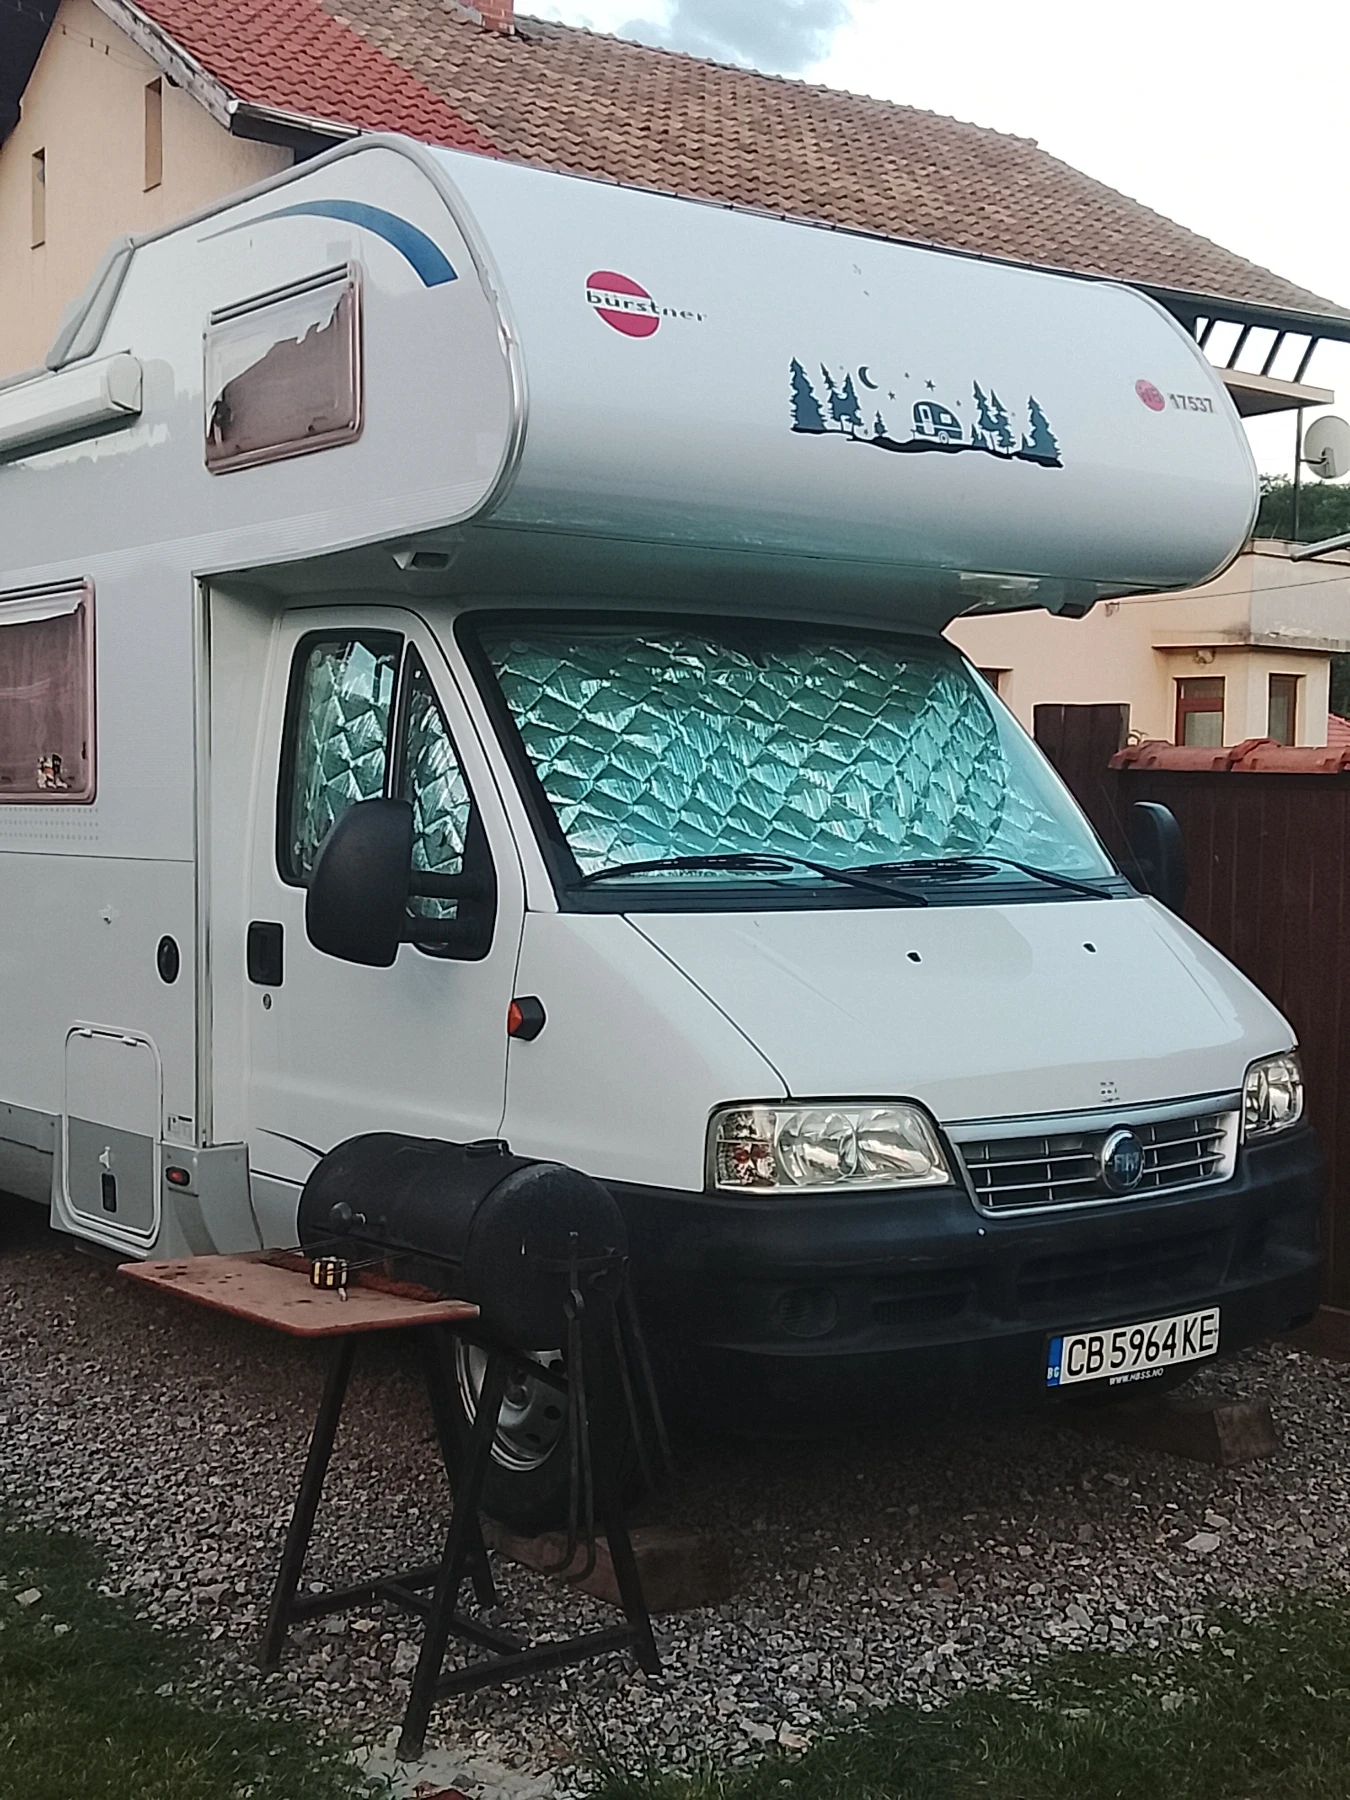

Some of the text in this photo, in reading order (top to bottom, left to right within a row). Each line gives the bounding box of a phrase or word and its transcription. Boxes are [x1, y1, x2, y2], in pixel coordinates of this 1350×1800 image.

[586, 290, 707, 321] bürstner
[1169, 393, 1214, 413] 17537
[1046, 1366, 1060, 1380] BG
